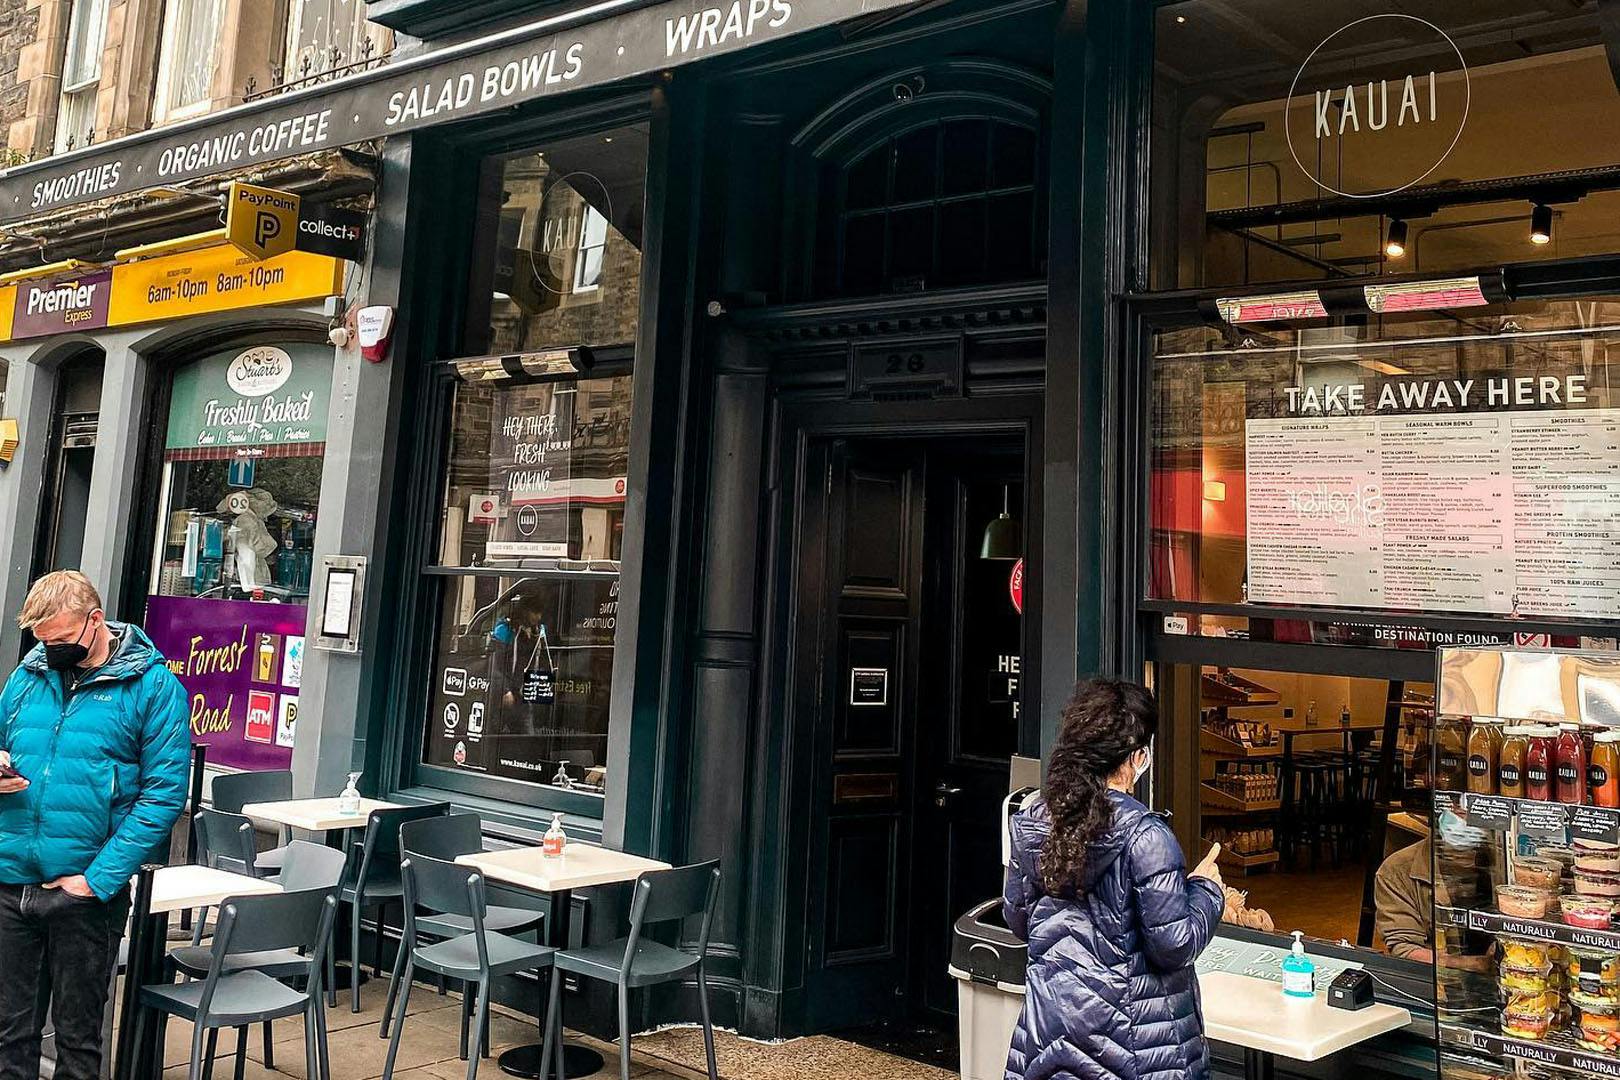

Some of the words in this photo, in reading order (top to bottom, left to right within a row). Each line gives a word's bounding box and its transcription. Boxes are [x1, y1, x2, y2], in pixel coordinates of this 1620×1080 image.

[665, 0, 792, 57] WRAPS
[384, 73, 475, 126] SALAD
[481, 43, 584, 102] BOWLS
[1316, 71, 1437, 138] KAUAI
[158, 131, 246, 177] ORGANIC
[249, 109, 331, 157] COFFEE
[31, 161, 122, 208] SMOOTHIES
[239, 190, 296, 212] PayPoint
[543, 216, 577, 252] KAU
[27, 281, 96, 315] Premier
[148, 279, 208, 304] 6am-10pm
[217, 266, 284, 292] 8am-10pm
[65, 309, 93, 325] Express
[1284, 384, 1365, 413] TAKE
[1377, 379, 1474, 410] AWAY
[1488, 375, 1587, 406] HERE
[204, 398, 263, 432] Freshly
[262, 391, 314, 424] Baked
[502, 416, 524, 440] HEY
[514, 442, 546, 464] FRESH
[508, 469, 550, 492] LOOKING
[1014, 569, 1023, 591] FAC
[1172, 621, 1185, 631] Pay
[1375, 628, 1453, 644] DESTINATION
[1457, 634, 1499, 644] FOUND
[165, 659, 185, 675] OME
[187, 624, 248, 677] Forrest
[998, 655, 1021, 673] HE
[451, 677, 463, 689] Pay
[190, 694, 234, 736] Road
[249, 708, 271, 726] ATM
[500, 759, 542, 772] www.kauai.co.uk
[1503, 922, 1557, 939] NATURALLY
[1572, 933, 1620, 950] NATURALL
[1243, 966, 1282, 980] WAIT
[1503, 1043, 1557, 1062] NATURALLY
[1573, 1058, 1620, 1076] NATURALL
